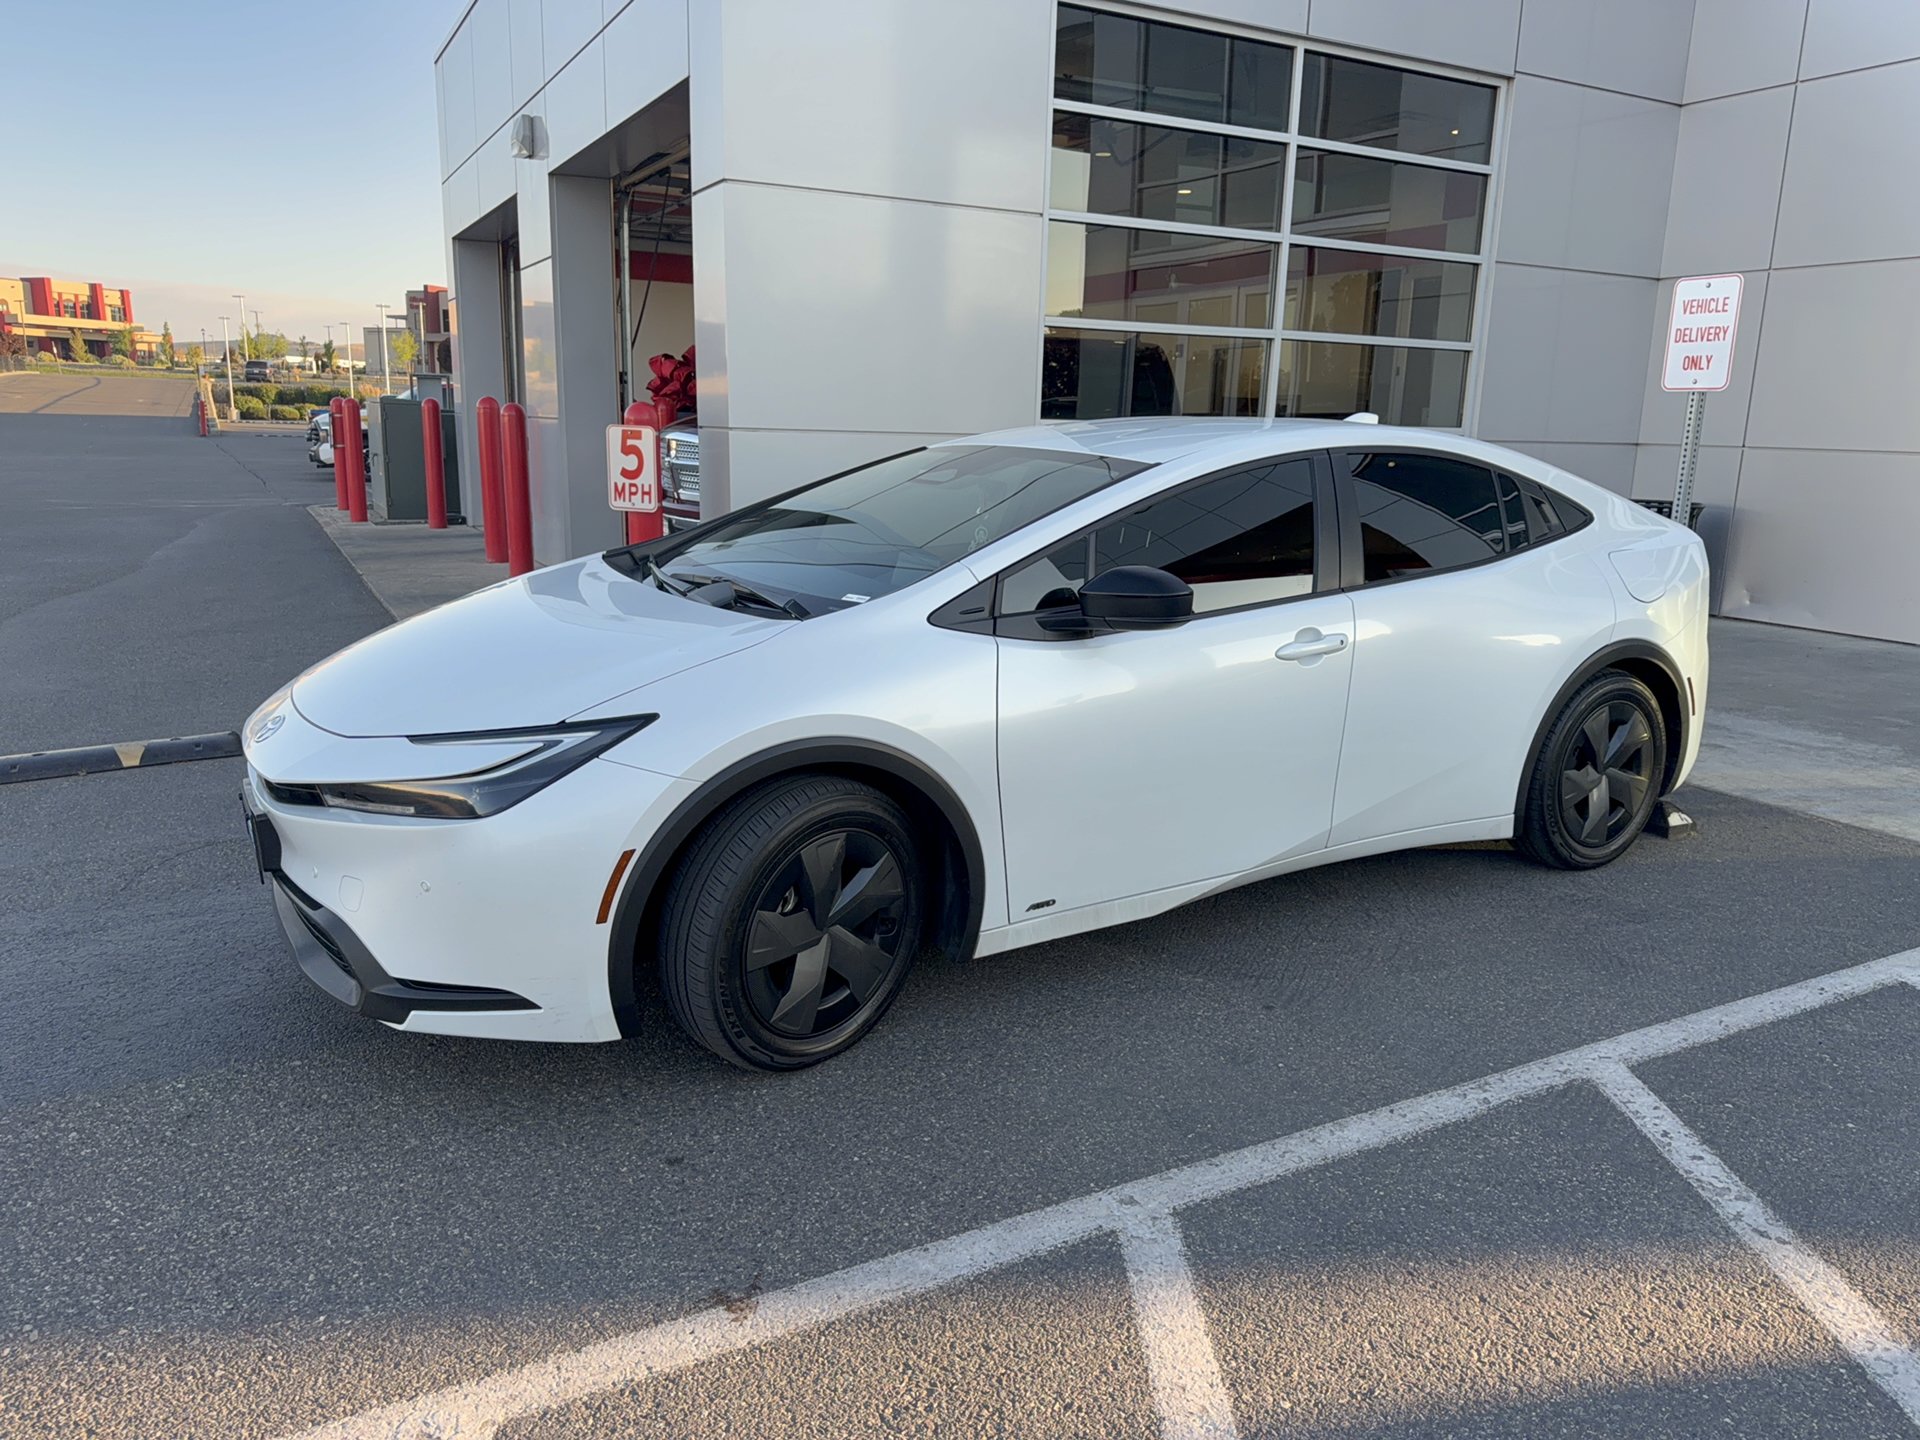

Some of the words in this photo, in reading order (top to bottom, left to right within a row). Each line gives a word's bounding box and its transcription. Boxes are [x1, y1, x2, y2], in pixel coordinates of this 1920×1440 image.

[1682, 297, 1730, 315] VEHICLE
[1674, 325, 1730, 343] DELIVERY
[1682, 355, 1713, 371] ONLY
[620, 429, 644, 480] 5
[614, 482, 652, 504] MPH
